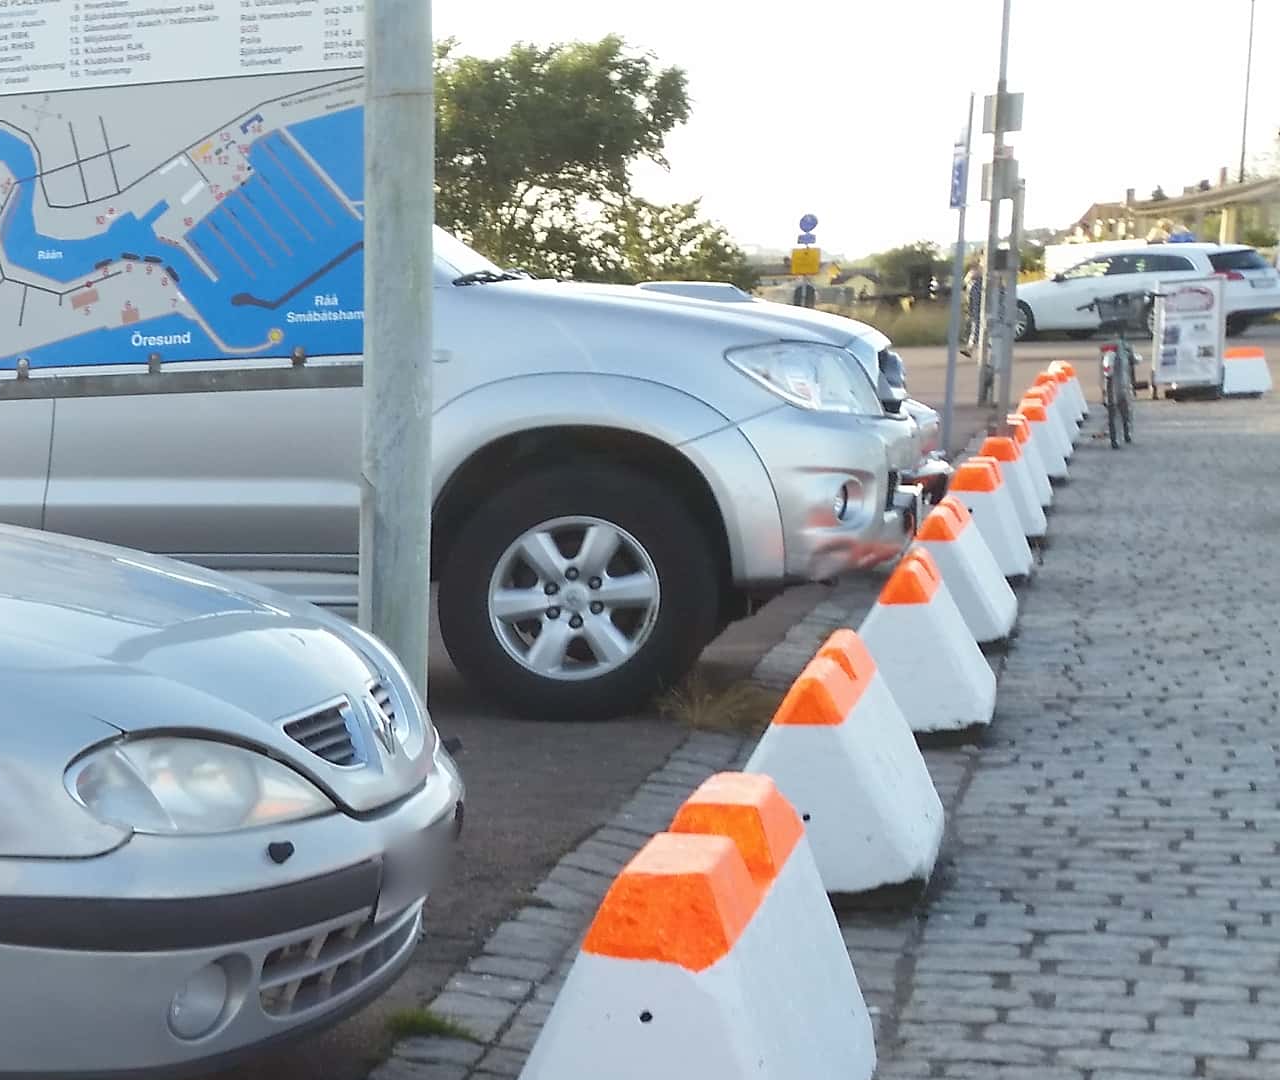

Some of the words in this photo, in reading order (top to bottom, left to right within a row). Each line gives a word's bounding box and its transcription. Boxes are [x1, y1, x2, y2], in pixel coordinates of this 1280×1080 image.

[314, 294, 339, 307] Råå
[287, 310, 365, 323] Småbåtsham
[131, 331, 192, 347] Öresund
